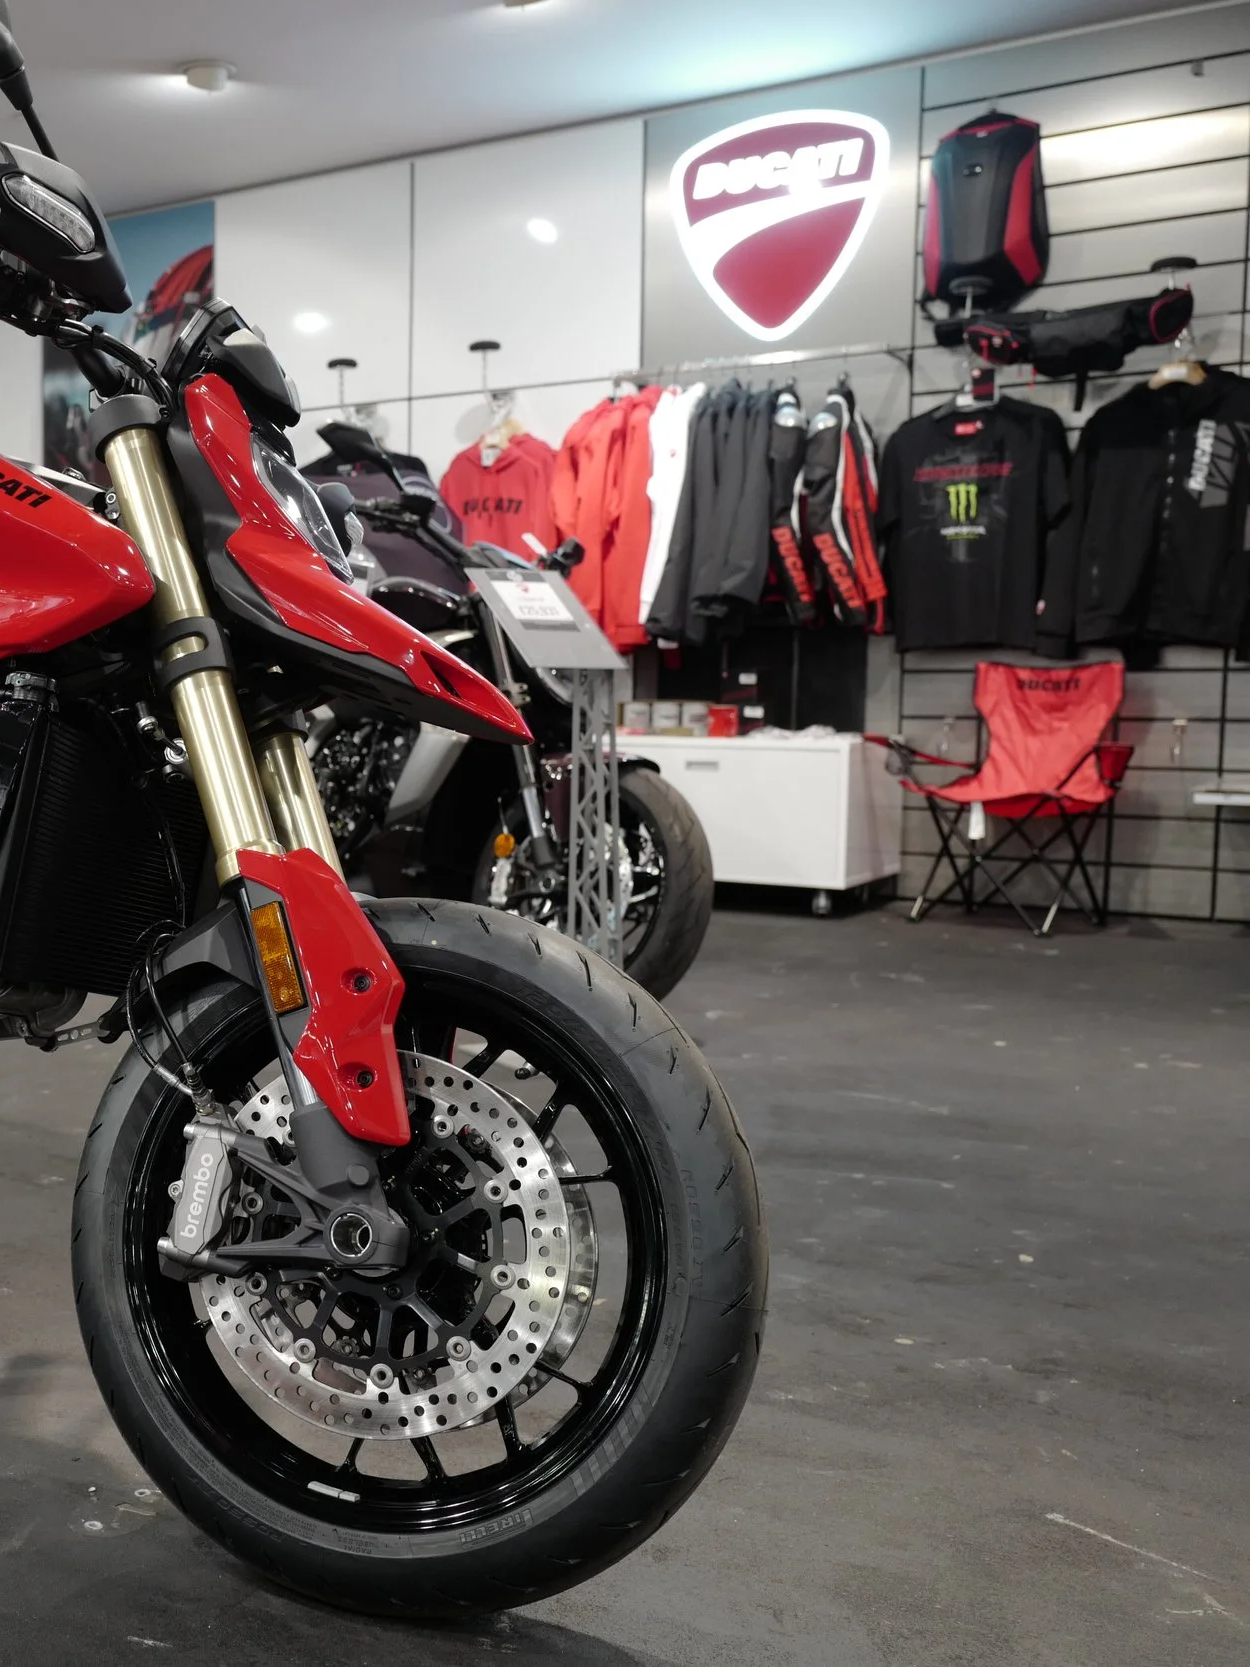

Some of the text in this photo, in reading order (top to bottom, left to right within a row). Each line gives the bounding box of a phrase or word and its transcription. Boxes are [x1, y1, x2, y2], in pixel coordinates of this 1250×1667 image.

[692, 137, 865, 200] DUCATI
[1187, 418, 1217, 491] DUCATI
[812, 532, 865, 608] DUCATI
[180, 1153, 214, 1238] brembo
